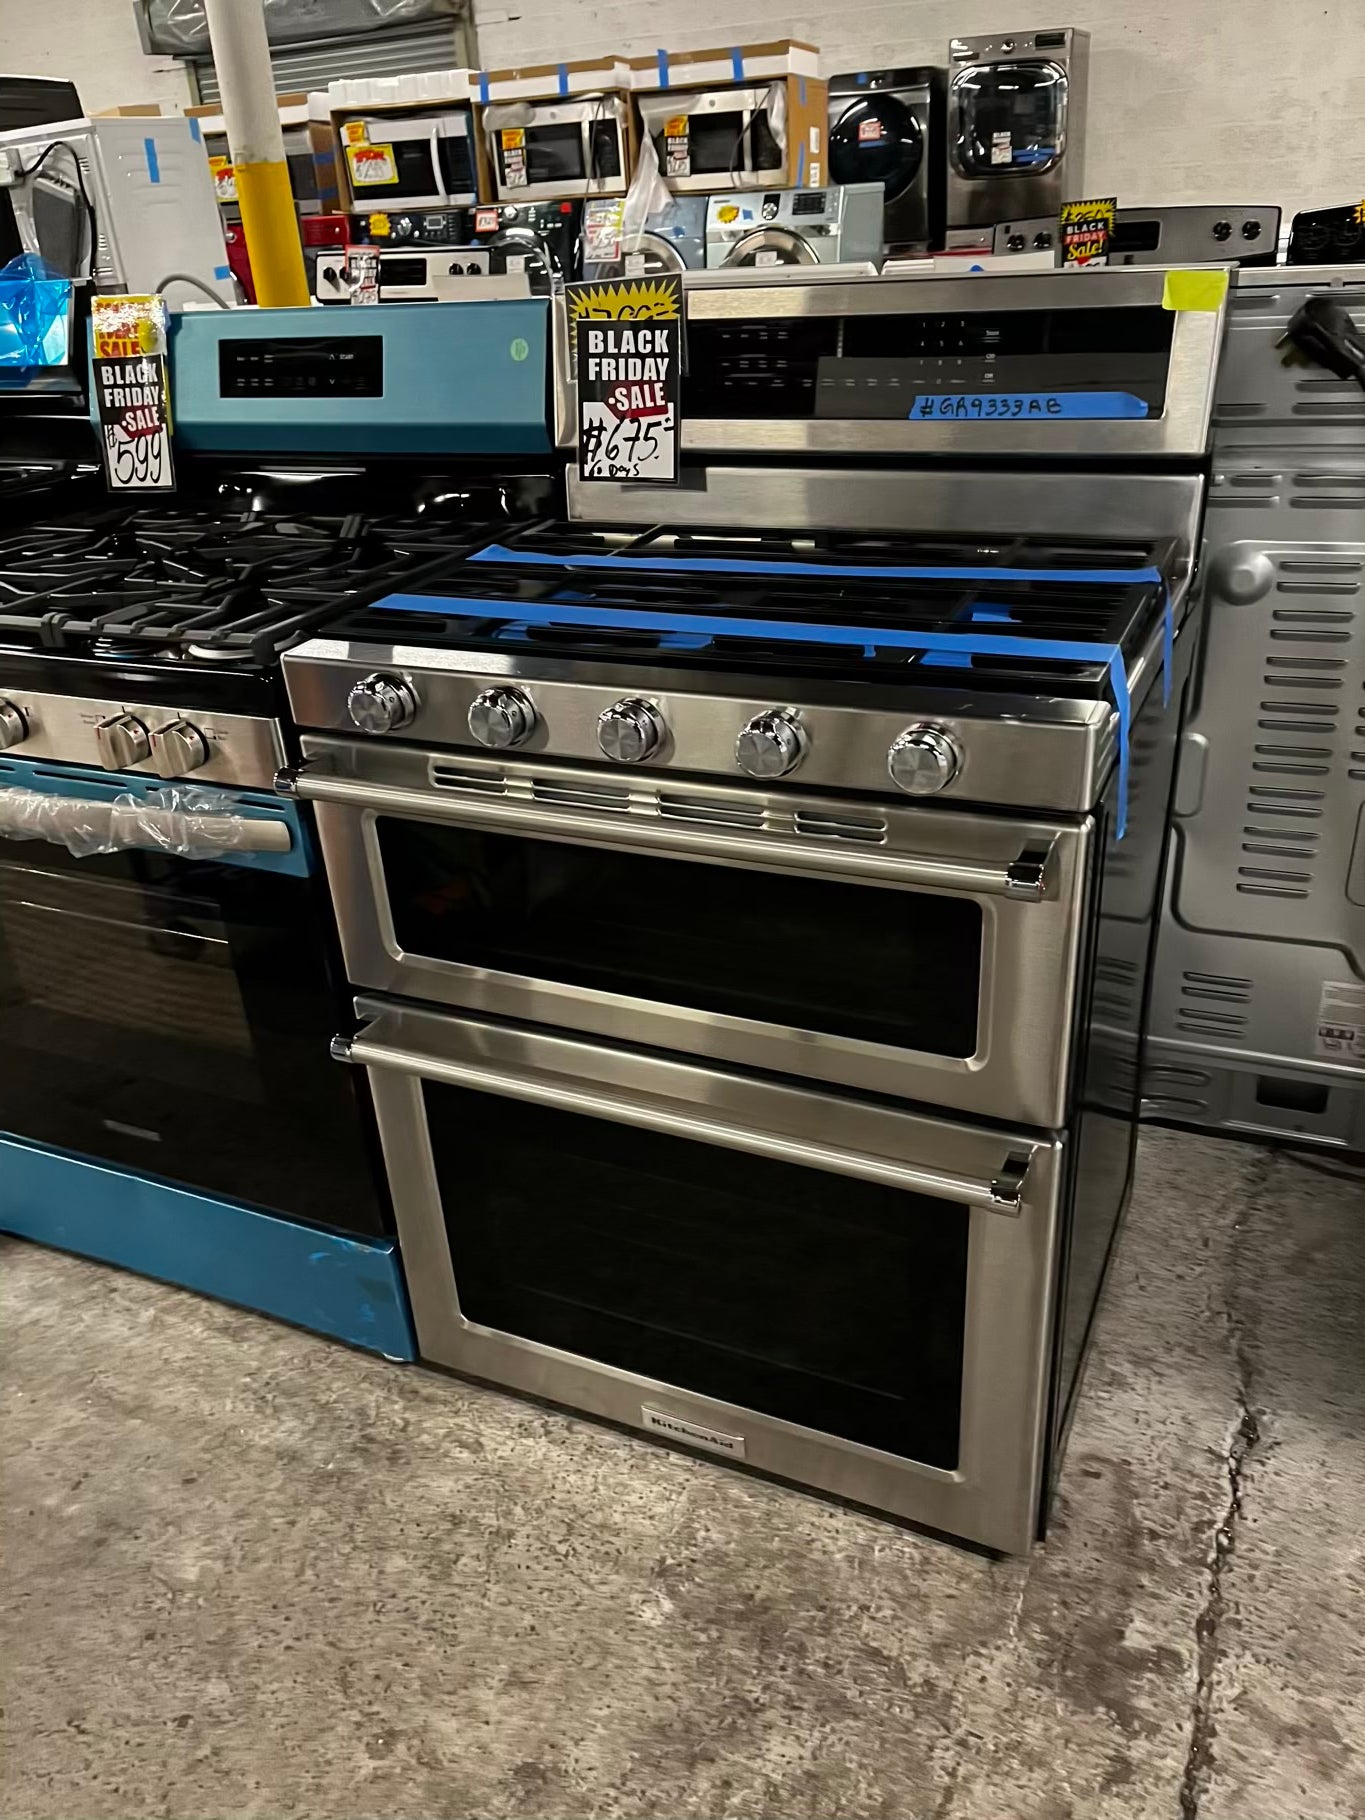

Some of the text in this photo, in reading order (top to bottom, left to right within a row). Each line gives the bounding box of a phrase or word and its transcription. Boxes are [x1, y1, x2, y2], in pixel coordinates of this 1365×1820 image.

[1065, 231, 1106, 244] FRIDAY
[1067, 221, 1104, 234] BLACK
[1066, 239, 1104, 260] Sale!
[588, 329, 669, 354] BLACK
[101, 362, 159, 386] BLACK
[588, 357, 670, 381] FRIDAY
[103, 385, 160, 408] FRIDAY
[614, 382, 666, 411] SALE
[124, 406, 161, 432] SALE
